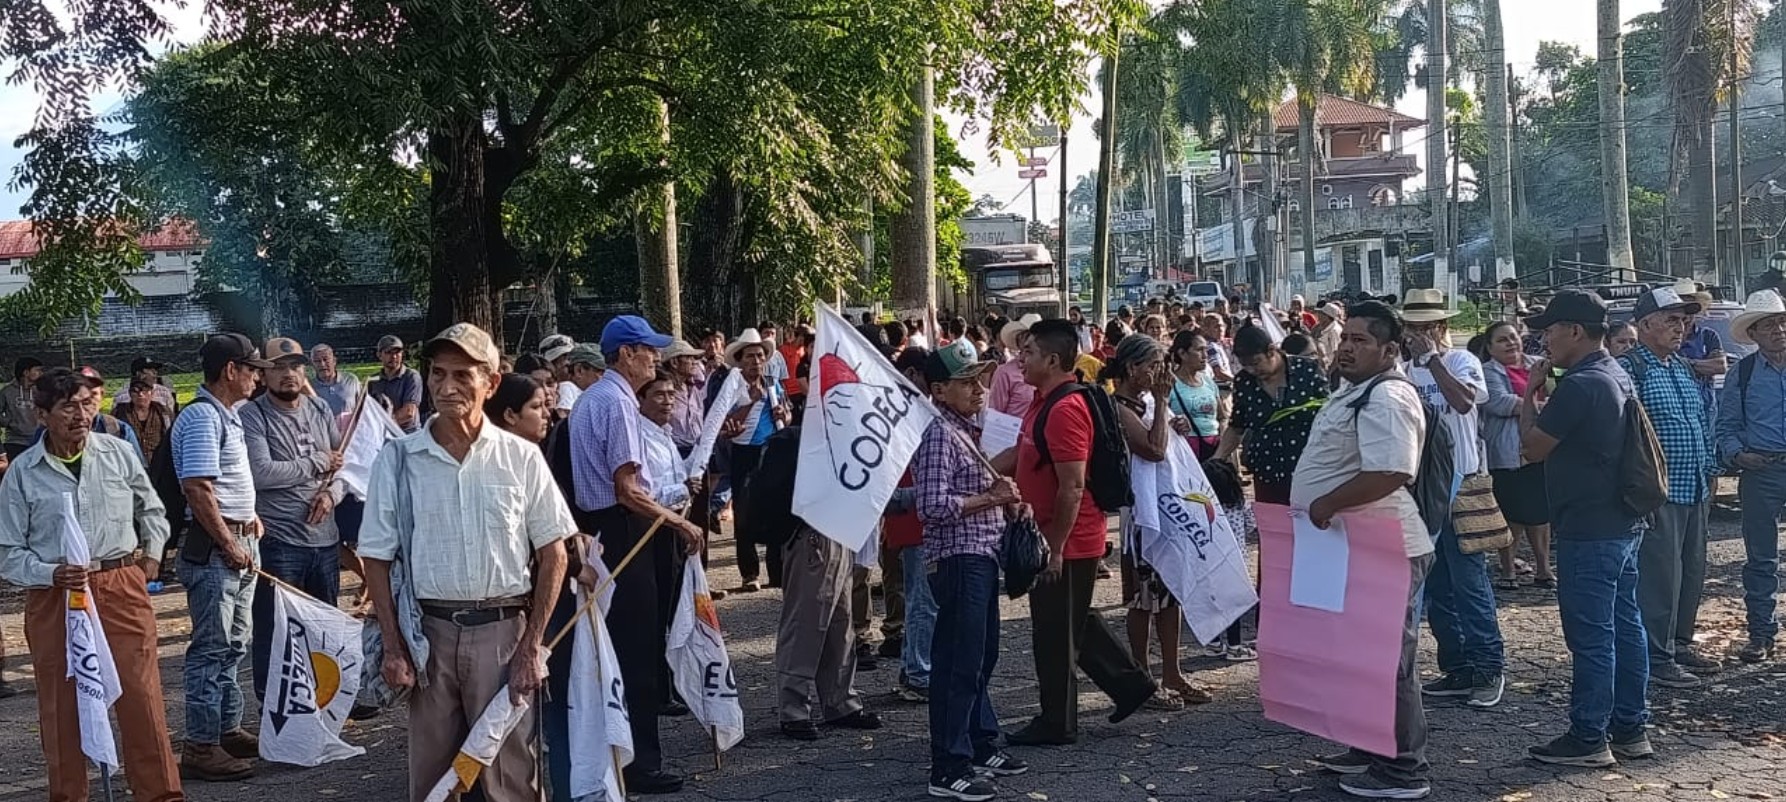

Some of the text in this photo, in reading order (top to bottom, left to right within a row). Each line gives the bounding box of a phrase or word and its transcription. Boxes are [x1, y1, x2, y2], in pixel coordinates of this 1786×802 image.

[839, 380, 920, 491] CODECA
[1158, 493, 1209, 548] CODECA
[287, 616, 317, 715] CECA
